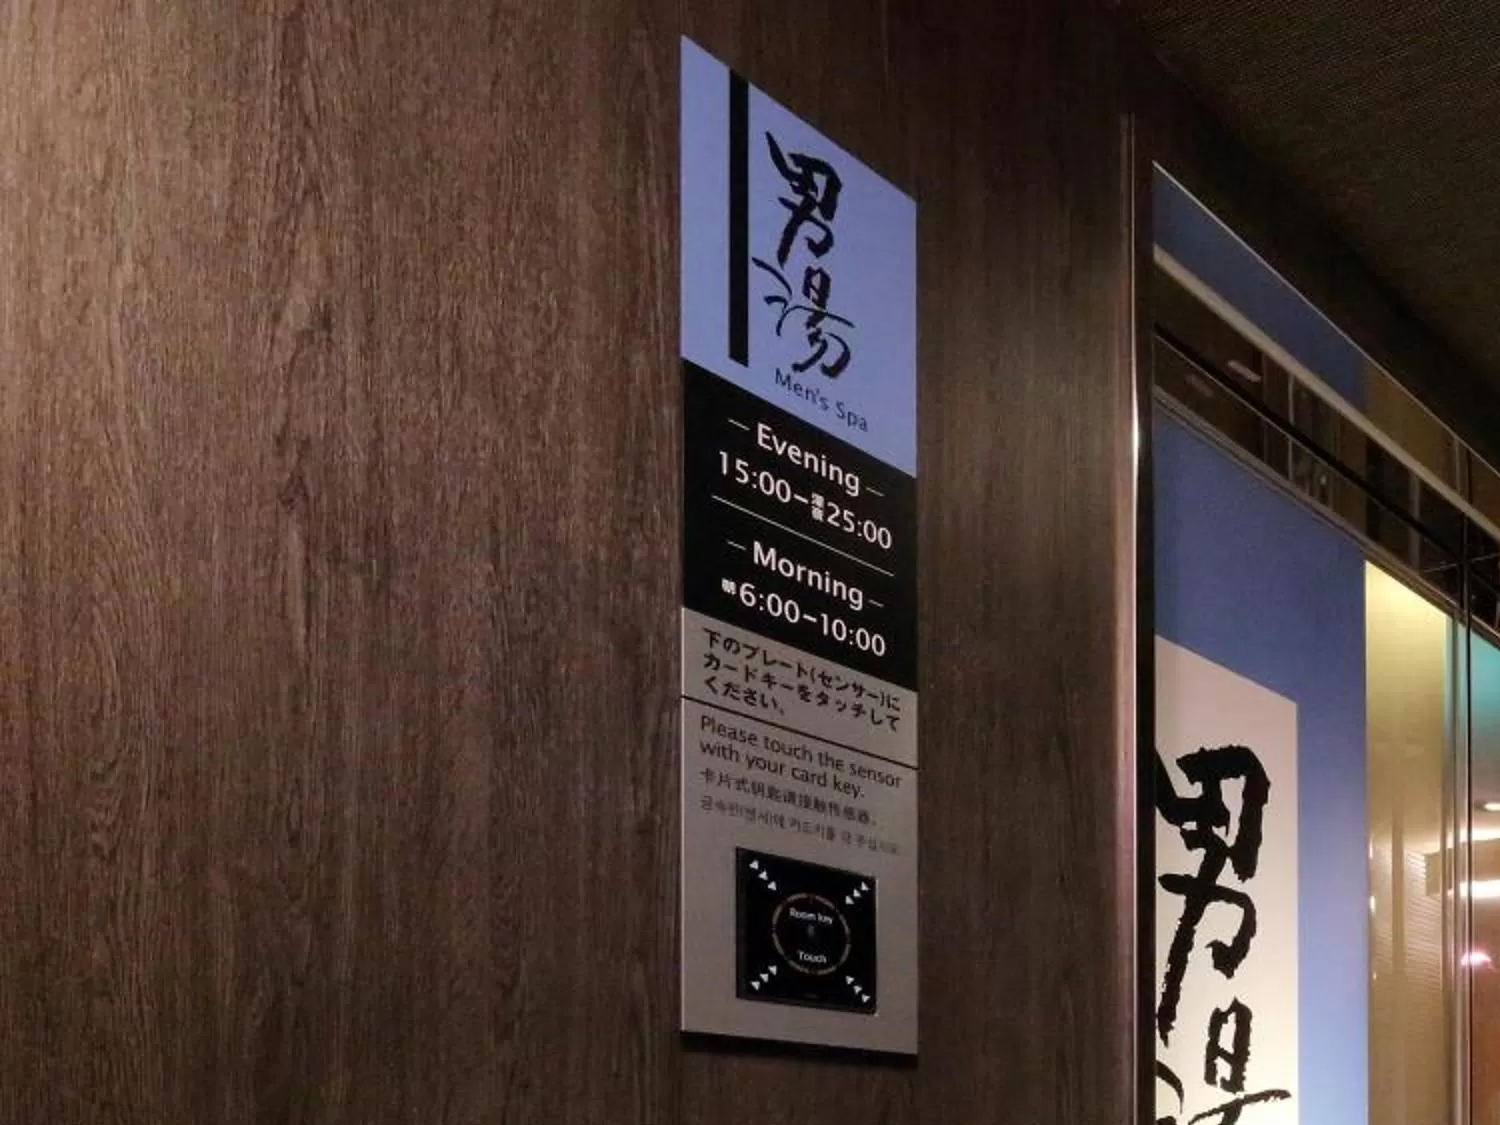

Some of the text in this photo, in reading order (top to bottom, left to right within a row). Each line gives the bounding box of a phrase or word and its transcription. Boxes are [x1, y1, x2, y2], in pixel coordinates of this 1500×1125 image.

[775, 367, 869, 432] Men's Spa
[756, 422, 860, 497] Evening
[753, 540, 864, 611] Morning
[700, 739, 866, 800] with your card key.
[701, 714, 903, 789] Please touch the sensor
[798, 950, 828, 964] Touch
